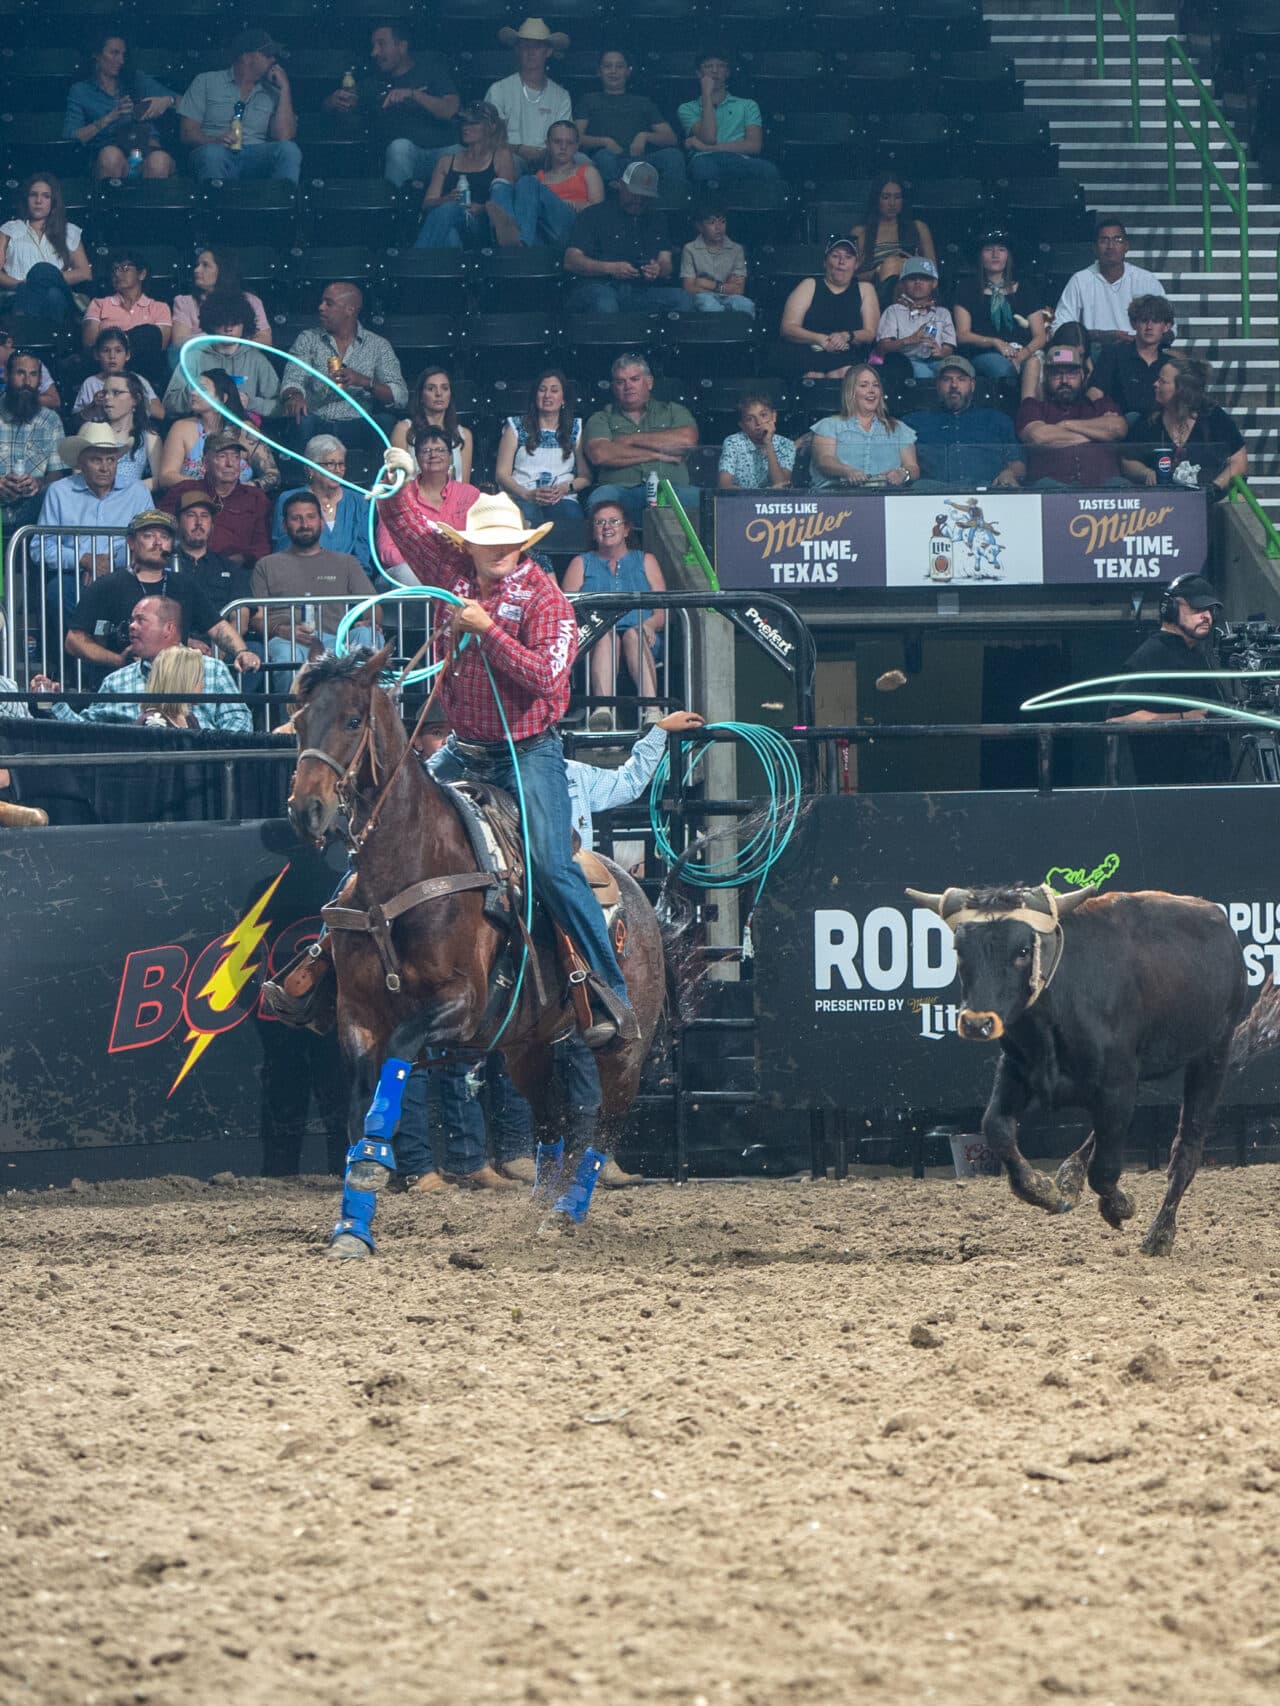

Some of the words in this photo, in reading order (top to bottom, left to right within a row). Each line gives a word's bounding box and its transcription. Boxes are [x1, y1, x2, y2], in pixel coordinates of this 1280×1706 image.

[755, 503, 793, 514] TASTES
[795, 503, 818, 514] LIKE
[1079, 499, 1116, 510] TASTES
[1117, 499, 1141, 510] LIKE
[745, 510, 852, 559] Miller
[1069, 505, 1174, 555] Miller
[800, 540, 858, 562] TIME,
[932, 541, 951, 555] Lite
[1123, 536, 1180, 557] TIME,
[770, 562, 839, 584] TEXAS
[1093, 558, 1161, 579] TEXAS
[814, 906, 958, 991] ROD
[815, 999, 885, 1012] PRESENTED
[888, 998, 904, 1011] BY
[919, 1003, 959, 1040] Lit
